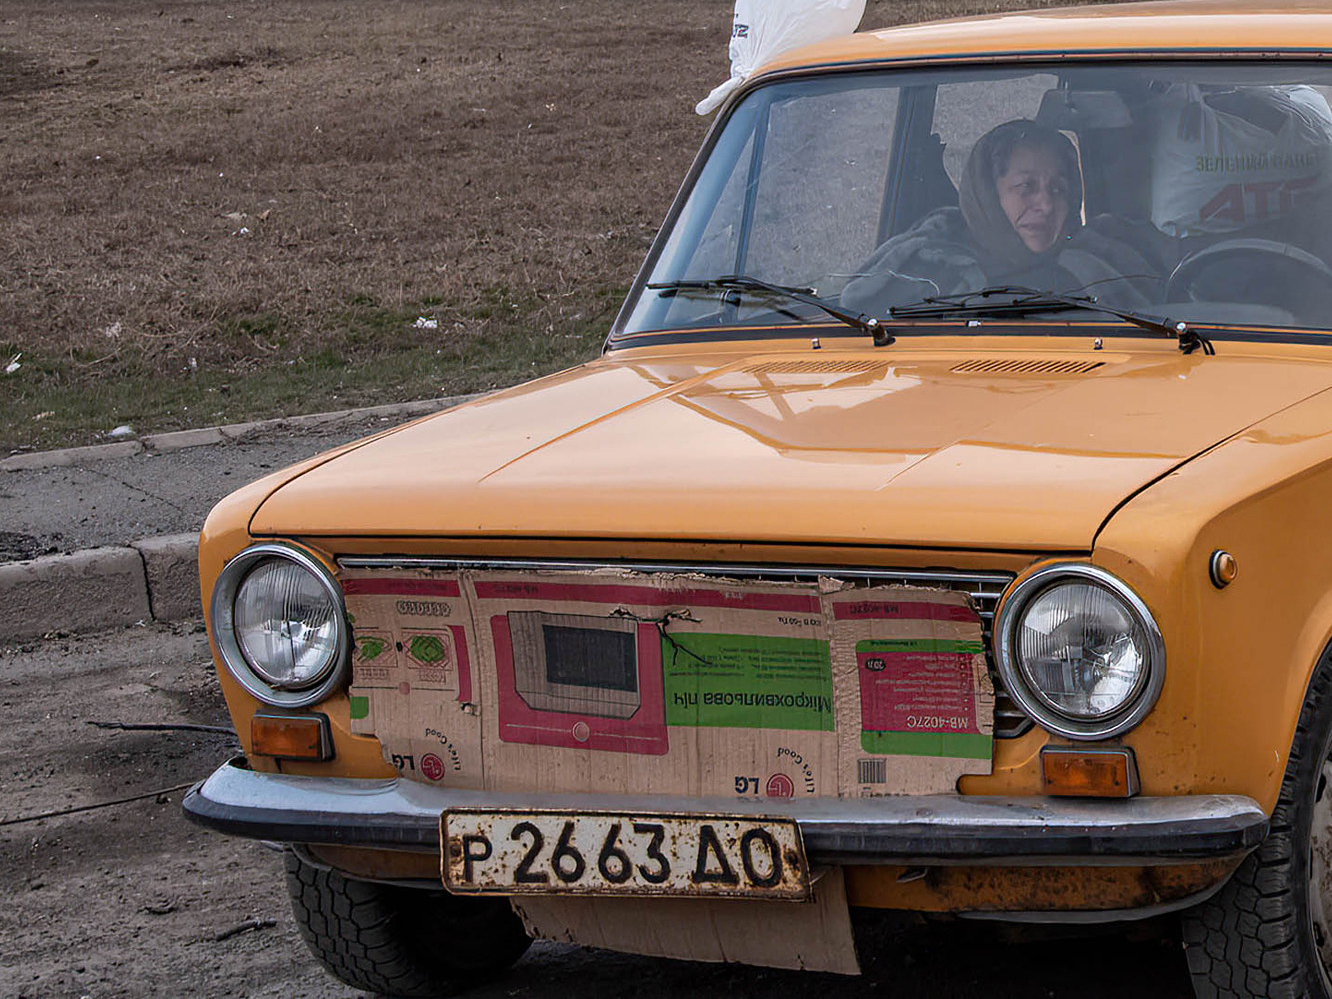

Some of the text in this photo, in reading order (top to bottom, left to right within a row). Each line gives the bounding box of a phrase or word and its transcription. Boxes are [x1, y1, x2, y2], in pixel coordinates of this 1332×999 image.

[674, 691, 832, 713] Мікрохвильова піч
[906, 715, 969, 729] MB-4027C
[392, 753, 415, 770] LG
[734, 776, 760, 795] LG
